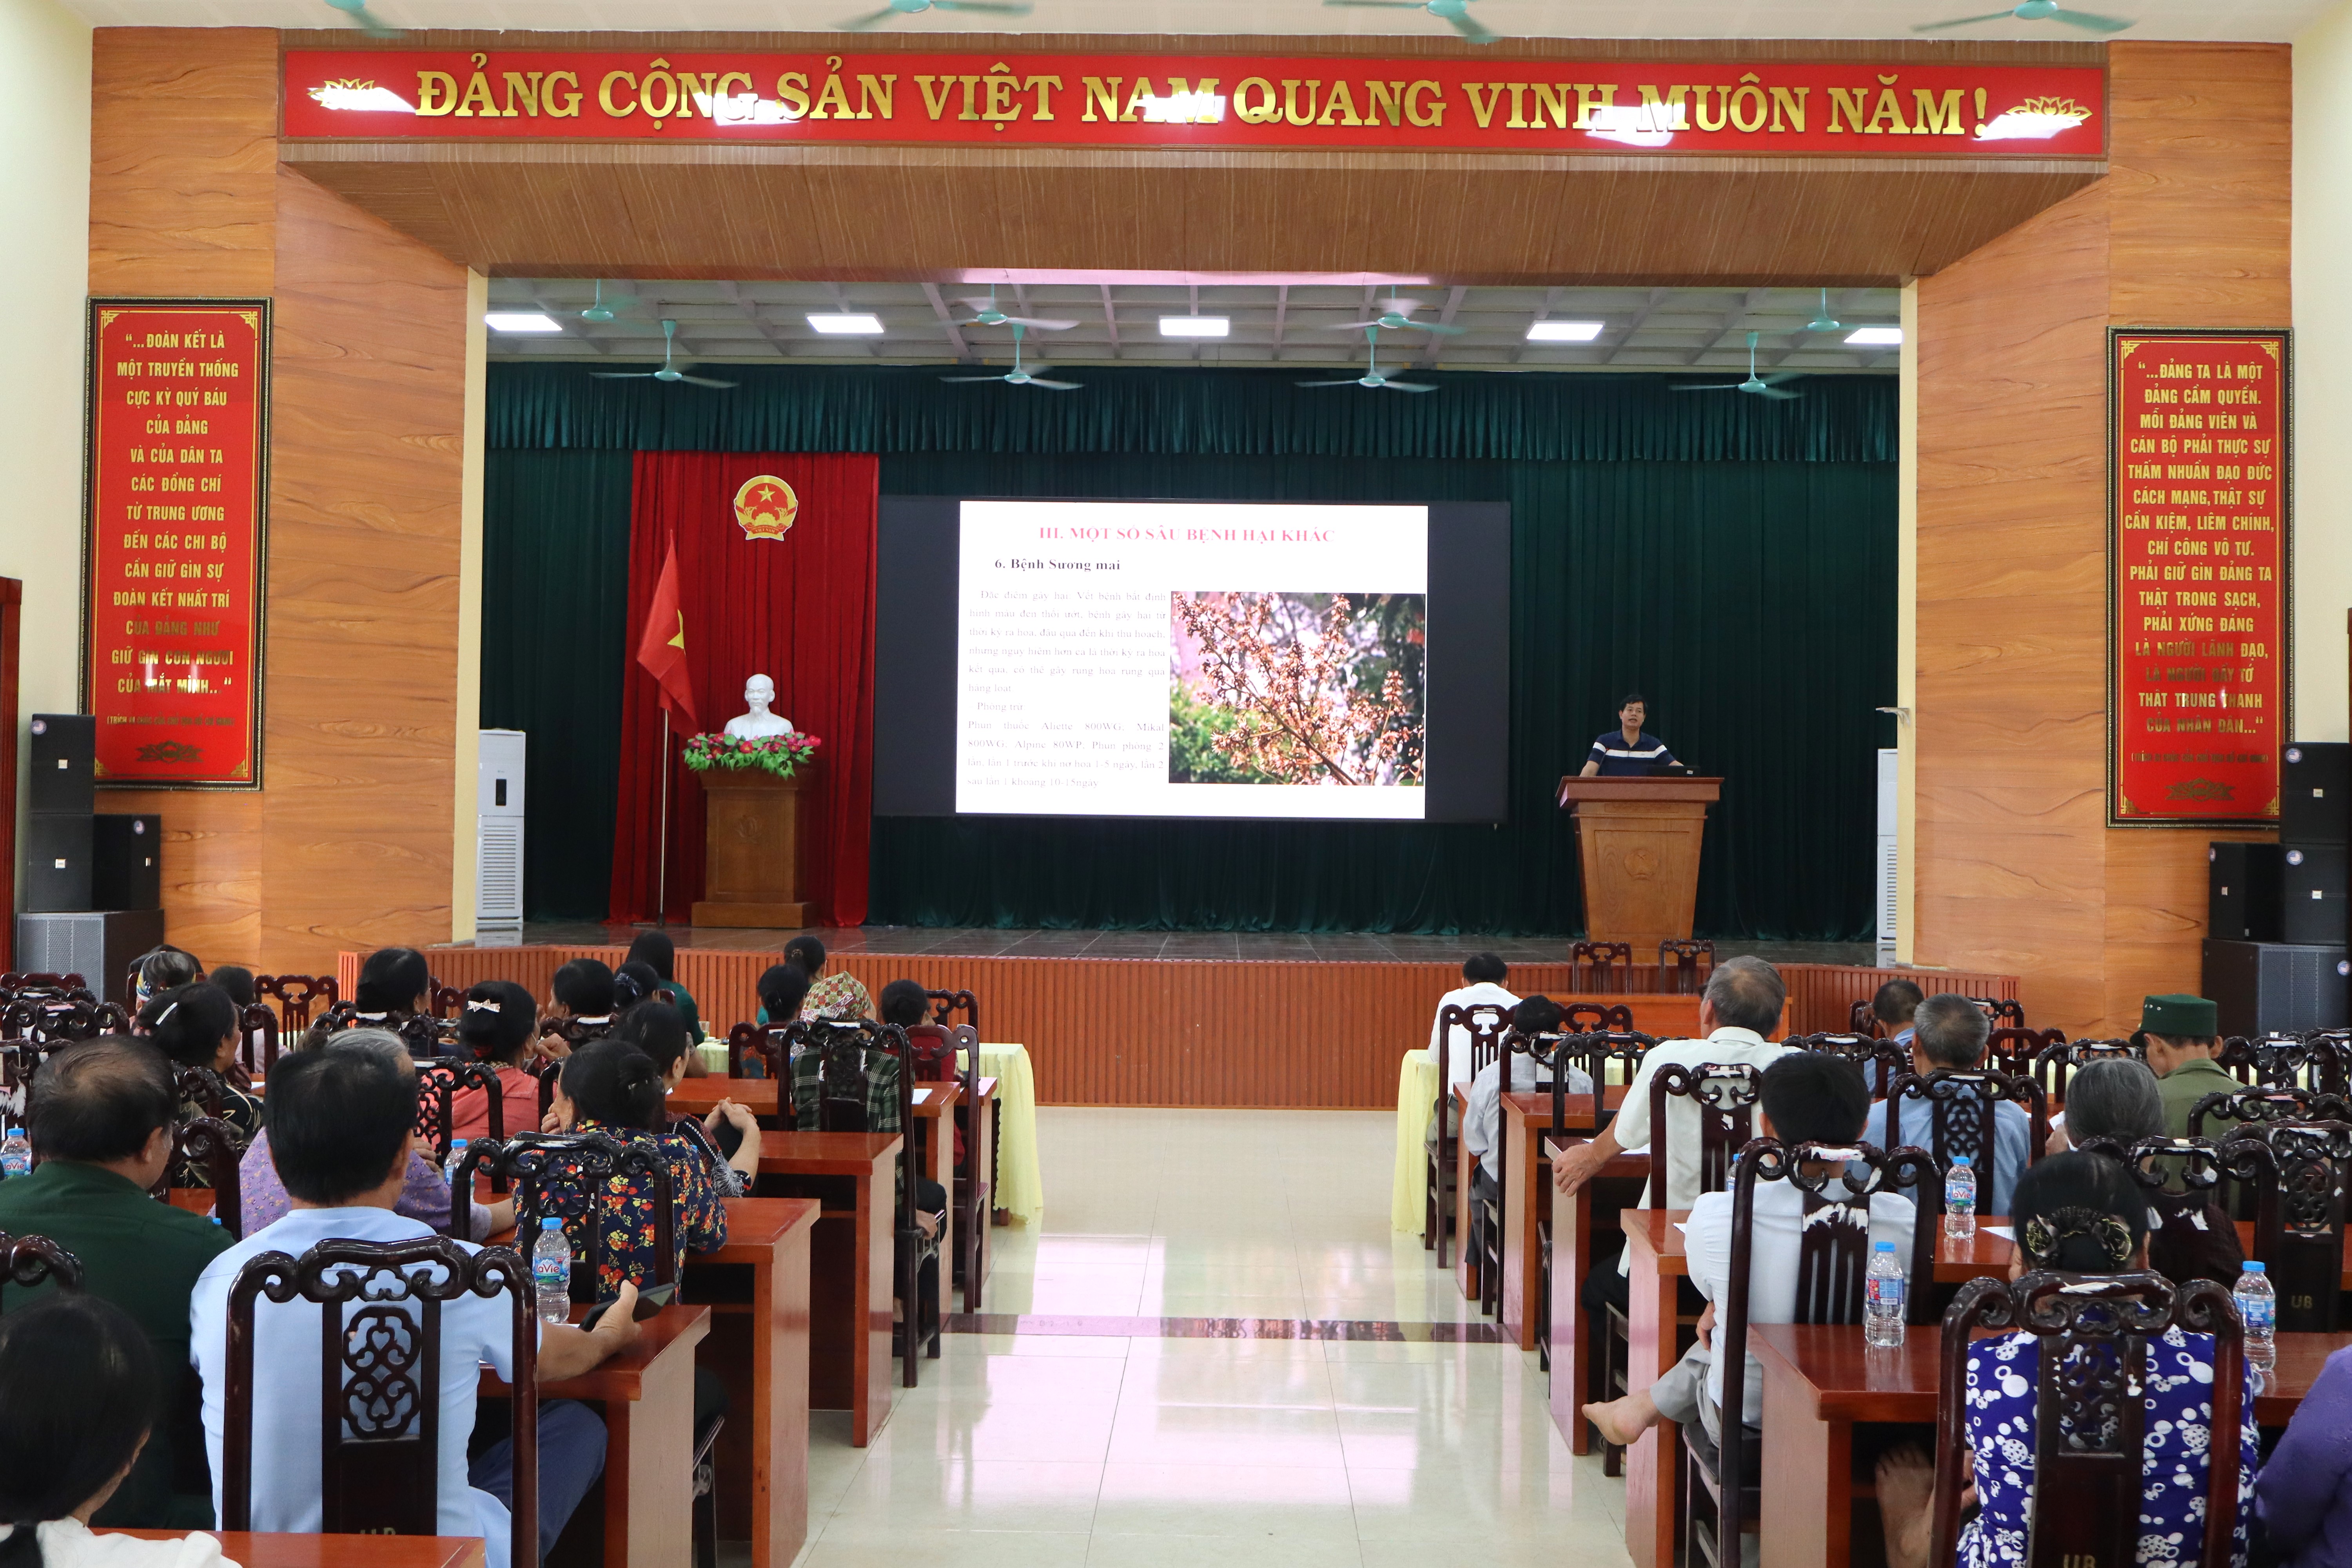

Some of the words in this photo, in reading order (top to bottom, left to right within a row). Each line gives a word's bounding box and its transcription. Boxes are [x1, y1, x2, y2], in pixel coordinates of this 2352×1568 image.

[415, 53, 583, 117] ĐẢNG
[598, 58, 759, 130] CỘNG
[775, 56, 897, 119] SẢN
[914, 62, 1063, 131] VIỆT
[1081, 76, 1220, 123] NAM
[1233, 77, 1447, 126] QUANG
[1461, 82, 1618, 130] VINH
[1637, 72, 1810, 132] MUÔN
[1827, 74, 1987, 136] NĂM!
[183, 329, 207, 348] KẾT
[209, 330, 225, 348] LÀ
[116, 359, 143, 379] MỘT
[147, 358, 195, 377] TRUYỀN
[198, 358, 240, 377] THỐNG
[2196, 364, 2212, 379] TA
[2216, 361, 2233, 379] LÀ
[2236, 361, 2264, 383] MỘT
[125, 390, 151, 408] CỰC
[155, 387, 172, 405] KỲ
[175, 387, 200, 407] QUÝ
[202, 387, 228, 406] BÁU
[2144, 383, 2180, 404] ĐẢNG
[2182, 384, 2212, 403] CẦM
[2217, 385, 2262, 405] QUYỀN.
[145, 414, 170, 434] CỦA
[175, 414, 209, 434] ĐẢNG
[2139, 407, 2165, 429] MỖI
[2168, 408, 2204, 428] ĐẢNG
[2207, 411, 2238, 429] VIÊN
[2242, 411, 2258, 429] VÀ
[129, 445, 146, 463] VÀ
[149, 442, 175, 463] CỦA
[180, 445, 205, 464] DÂN
[209, 448, 224, 463] TA
[2129, 434, 2157, 453] CÁN
[2160, 434, 2179, 457] BỘ
[2183, 433, 2214, 454] PHẢI
[2216, 438, 2249, 458] THỰC
[2253, 439, 2272, 458] SỰ
[131, 473, 155, 491] CÁC
[160, 472, 196, 492] ĐỒNG
[200, 474, 222, 492] CHÍ
[2126, 460, 2163, 479] THẤM
[2167, 460, 2211, 479] NHUẦN
[2216, 465, 2242, 483] ĐẠO
[2247, 462, 2274, 480] ĐỨC
[2133, 486, 2165, 504] CÁCH
[2171, 489, 2211, 509] MẠNG,
[2213, 487, 2243, 509] THẬT
[2247, 489, 2268, 509] SỰ
[125, 501, 144, 520] TỪ
[145, 505, 188, 521] TRUNG
[191, 505, 225, 521] ƯƠNG
[2125, 510, 2150, 529] CẦN
[2155, 511, 2192, 533] KIỆM,
[2196, 512, 2227, 530] LIÊM
[2232, 512, 2274, 532] CHÍNH,
[123, 529, 149, 549] ĐẾN
[153, 531, 179, 549] CÁC
[183, 534, 207, 549] CHI
[210, 531, 227, 553] BỘ
[1040, 527, 1063, 539] III.
[1070, 526, 1111, 543] MỘT
[1117, 525, 1140, 540] SỐ
[1145, 524, 1180, 540] SÂU
[1187, 527, 1236, 544] BỆNH
[1243, 529, 1274, 544] HẠI
[1282, 526, 1334, 542] KHÁC
[2147, 537, 2170, 555] CHÍ
[2173, 537, 2209, 555] CÔNG
[2213, 537, 2231, 556] VÔ
[2234, 540, 2255, 556] TƯ.
[124, 558, 151, 578] CẦN
[154, 559, 176, 578] GIỮ
[180, 560, 202, 578] GÌN
[206, 562, 225, 582] SỰ
[995, 559, 1005, 569] 6.
[1011, 558, 1044, 572] Bệnh
[1049, 559, 1091, 572] Sương
[1096, 560, 1120, 570] mai
[2129, 559, 2160, 580] PHẢI
[2163, 561, 2187, 581] GIỮ
[2190, 562, 2214, 581] GÌN
[2218, 560, 2254, 581] ĐẢNG
[2258, 566, 2272, 581] TA
[113, 588, 147, 606] ĐOÀN
[150, 588, 175, 607] KẾT
[177, 588, 208, 607] NHẤT
[211, 589, 230, 608] TRÍ
[2138, 587, 2170, 610] THẬT
[2174, 591, 2218, 606] TRONG
[2223, 591, 2261, 611] SẠCH,
[2142, 610, 2174, 631] PHẢI
[2179, 612, 2216, 632] XỨNG
[2219, 613, 2255, 632] ĐÁNG
[111, 646, 134, 664] GIỮ
[165, 650, 192, 664] CON
[2135, 638, 2151, 656] LÀ
[2240, 642, 2269, 661] ĐẠO,
[117, 673, 141, 693] CỦA
[147, 673, 172, 693] MẮT
[2239, 663, 2255, 682] TỚ
[2174, 692, 2216, 707] TRUNG
[2221, 690, 2263, 708] THÀNH
[2177, 715, 2212, 732] NHÂN
[2292, 1295, 2313, 1308] UB
